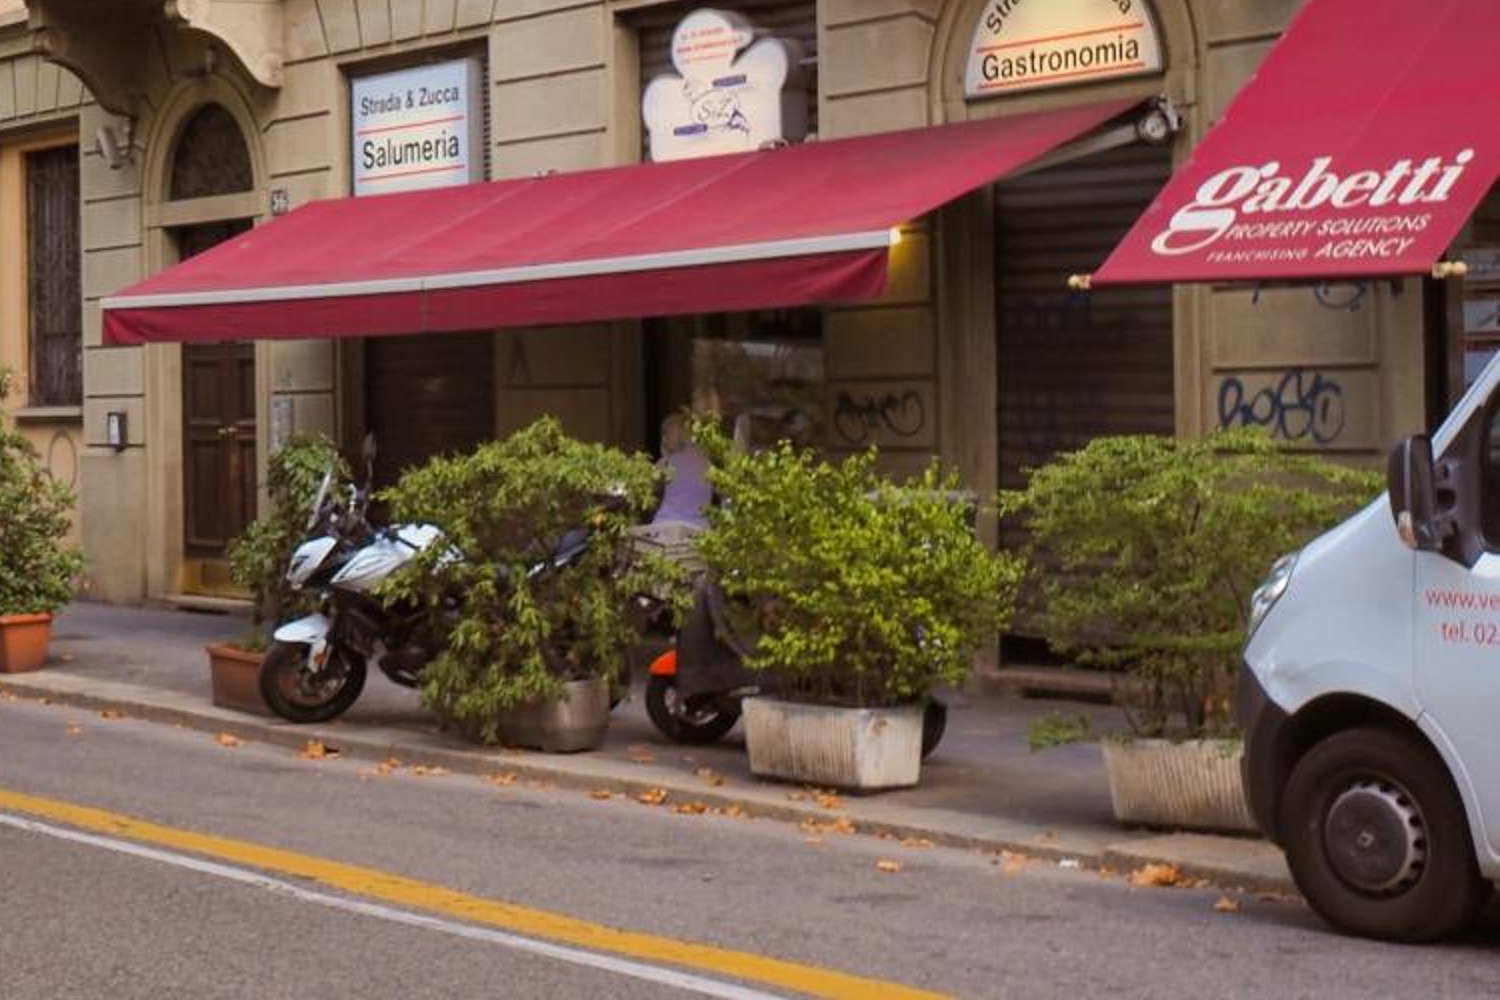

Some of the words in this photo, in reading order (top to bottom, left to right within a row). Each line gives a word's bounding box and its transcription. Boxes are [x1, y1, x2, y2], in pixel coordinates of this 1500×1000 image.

[981, 33, 1140, 81] Gastronomia
[361, 93, 401, 116] Strada
[419, 87, 459, 107] Zucca
[363, 130, 460, 169] Salumeria
[1151, 148, 1474, 255] gabetti
[1225, 221, 1313, 240] PROPERTY
[1317, 213, 1431, 234] SOLUTIONS
[1314, 238, 1415, 259] AGENCY
